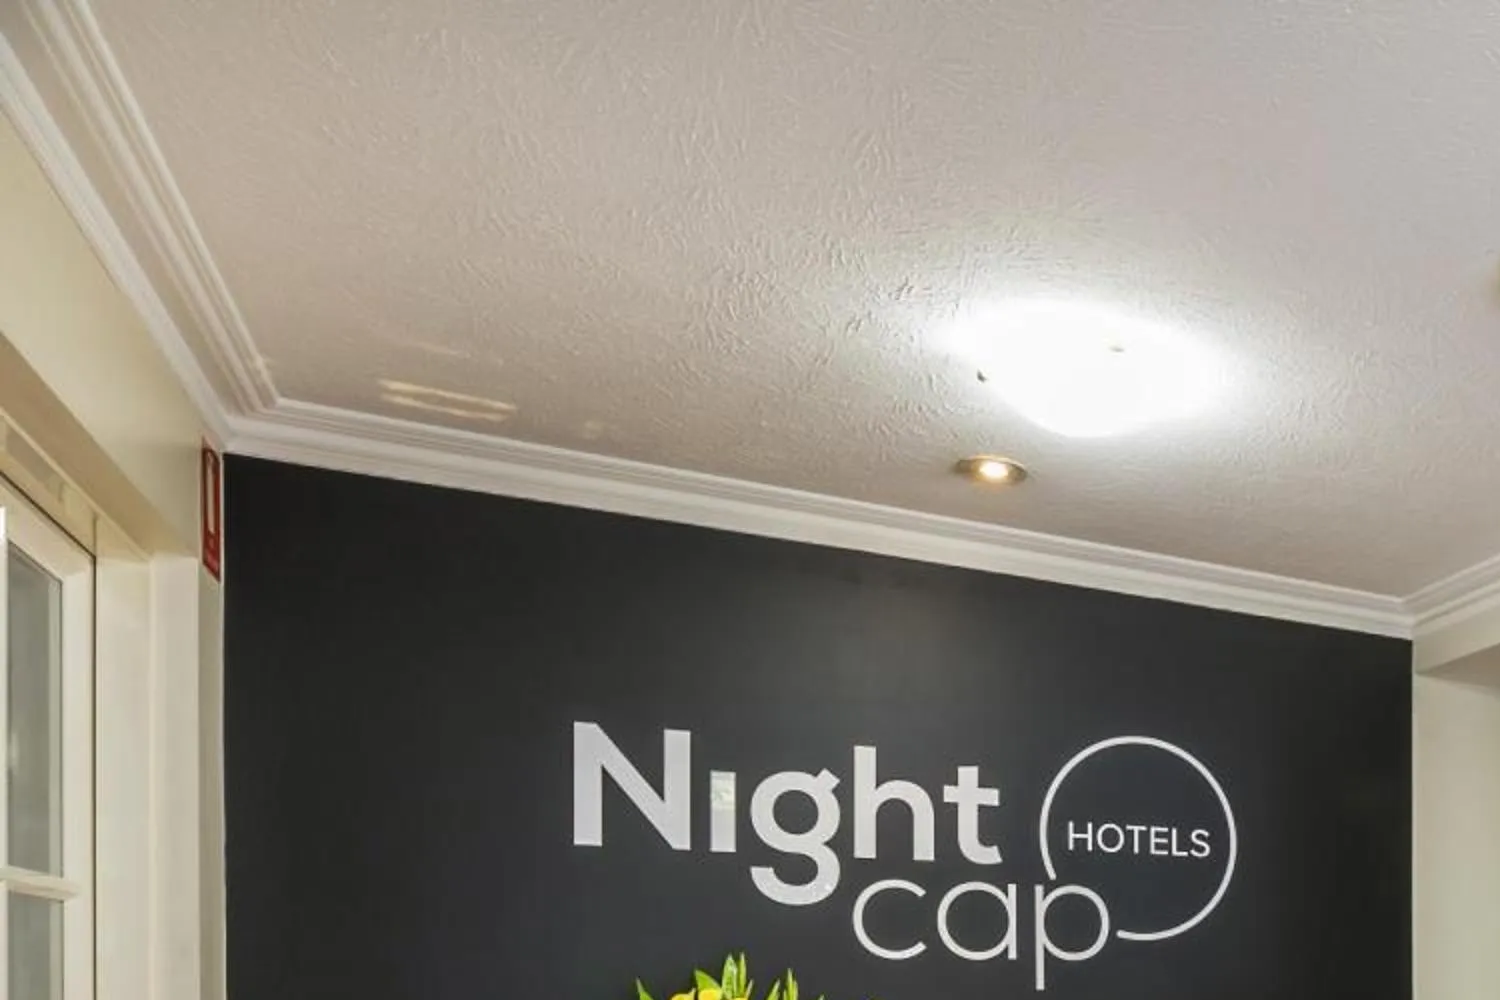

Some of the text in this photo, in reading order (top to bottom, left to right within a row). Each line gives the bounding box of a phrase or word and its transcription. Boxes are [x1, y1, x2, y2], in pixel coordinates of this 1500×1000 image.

[573, 720, 1003, 906] Night
[1066, 820, 1212, 859] HOTELS
[852, 878, 1110, 991] cap
